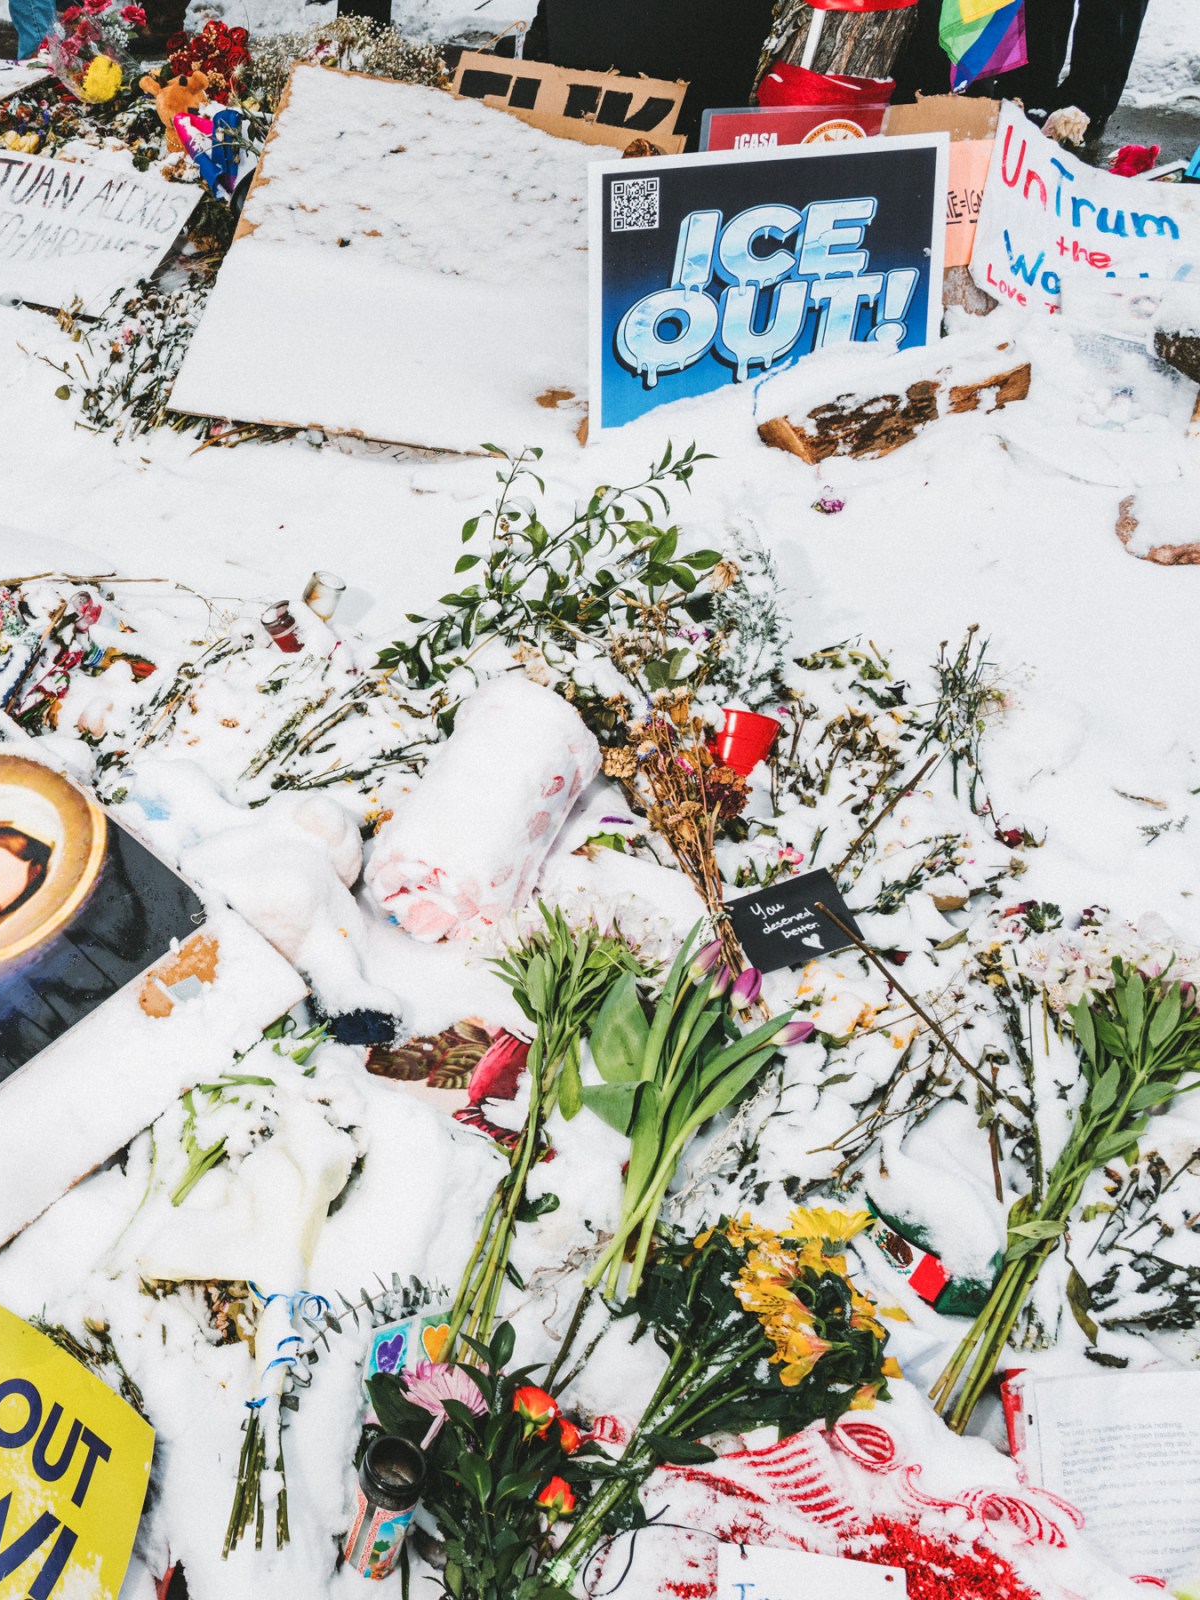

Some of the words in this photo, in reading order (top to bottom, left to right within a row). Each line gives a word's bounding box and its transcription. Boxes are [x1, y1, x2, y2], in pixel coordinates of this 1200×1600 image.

[671, 197, 878, 294] ICE
[1056, 236, 1112, 269] the
[987, 263, 1028, 307] Love
[614, 267, 920, 387] OUT!
[750, 902, 785, 920] You
[762, 907, 815, 935] deserved
